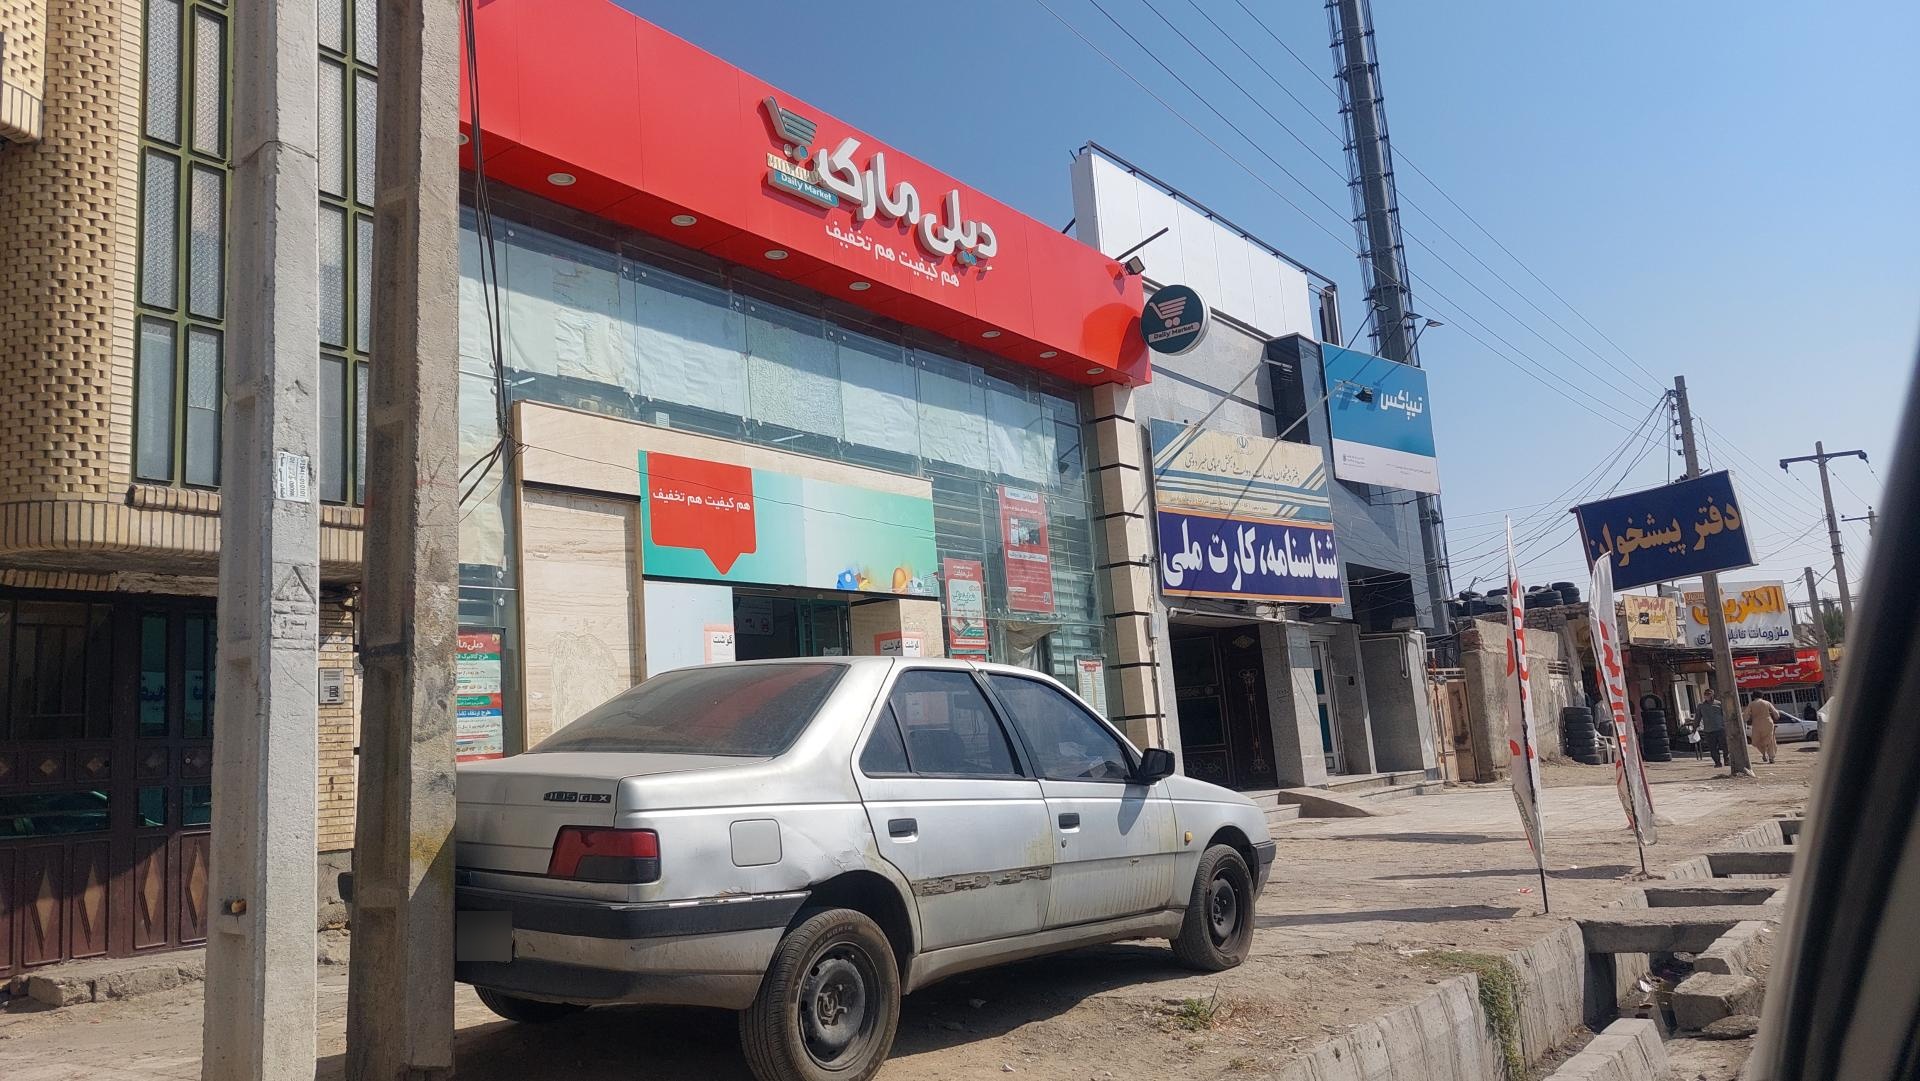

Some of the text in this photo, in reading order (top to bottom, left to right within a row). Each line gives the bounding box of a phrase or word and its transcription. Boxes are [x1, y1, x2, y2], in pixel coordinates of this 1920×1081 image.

[781, 173, 833, 201] Daily Market
[826, 221, 960, 287] هم کیفیت هم تخفیف
[919, 189, 998, 270] دیلی
[1153, 324, 1195, 339] Daily Market
[652, 488, 751, 513] هم کیفیت هم تخفیف
[1693, 496, 1741, 551] دفتر
[1163, 518, 1203, 587] ملی
[1208, 524, 1256, 590] کارت
[1748, 627, 1790, 641] ملزومات
